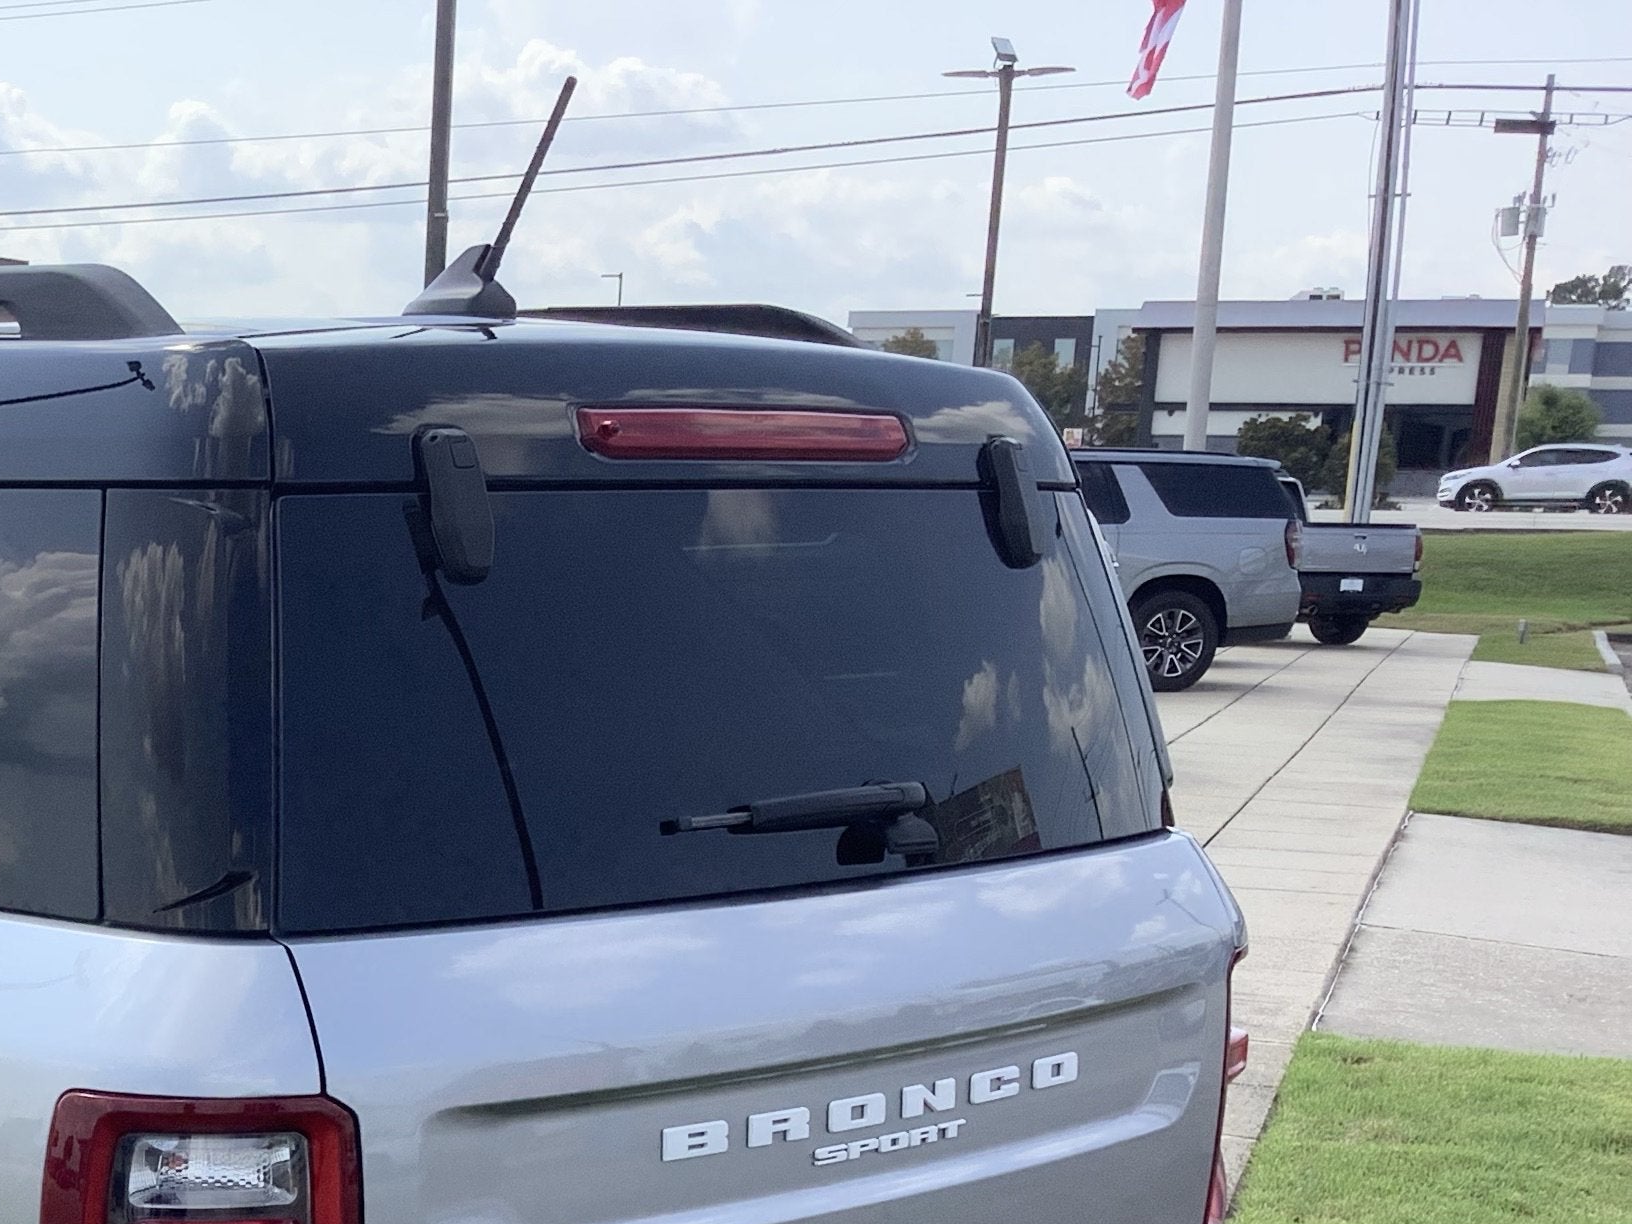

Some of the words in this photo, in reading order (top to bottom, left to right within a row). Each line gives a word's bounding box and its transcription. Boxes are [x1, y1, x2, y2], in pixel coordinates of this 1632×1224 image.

[1343, 338, 1465, 364] PNDA
[661, 1051, 1079, 1162] BRONCO
[812, 1118, 967, 1167] SPORT
